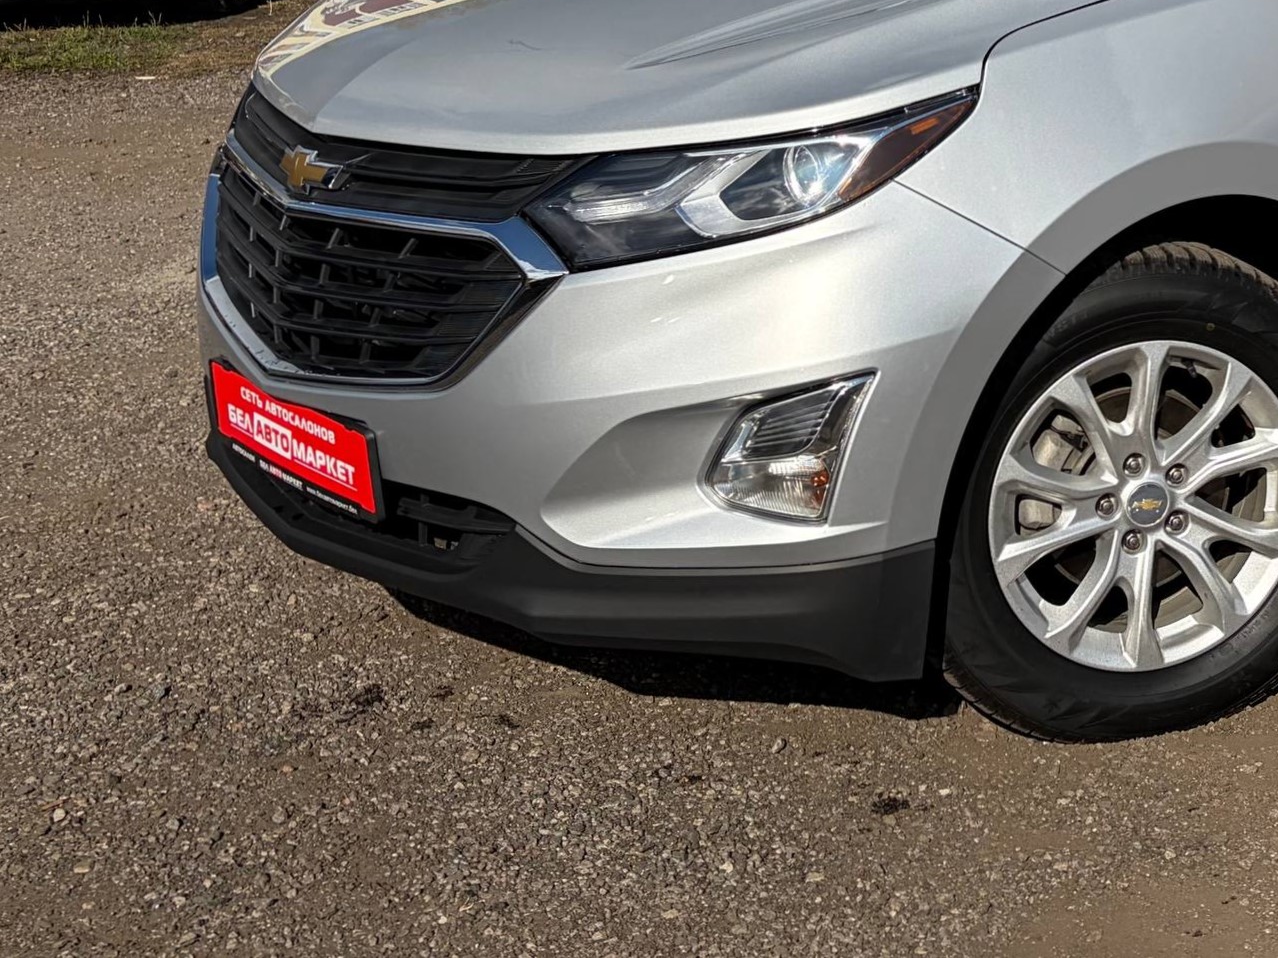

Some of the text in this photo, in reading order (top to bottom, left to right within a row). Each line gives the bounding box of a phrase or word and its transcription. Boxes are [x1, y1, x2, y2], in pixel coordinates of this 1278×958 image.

[228, 404, 355, 485] БЕЛ АВТО МАРКЕТ
[240, 387, 335, 445] СЕТЬ АВТОСАЛОНОВ
